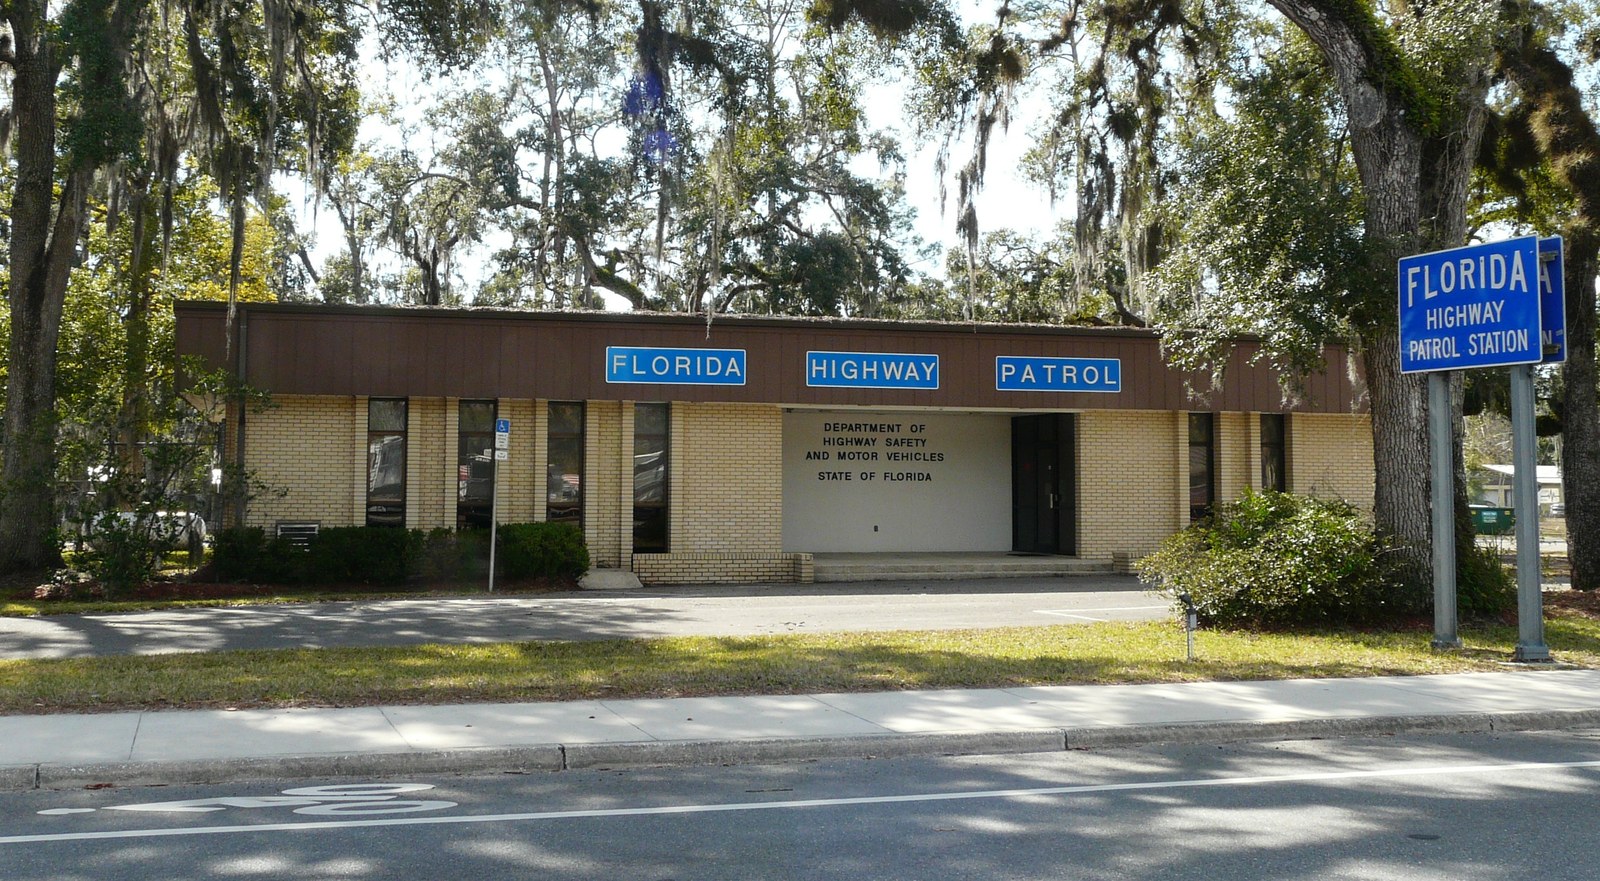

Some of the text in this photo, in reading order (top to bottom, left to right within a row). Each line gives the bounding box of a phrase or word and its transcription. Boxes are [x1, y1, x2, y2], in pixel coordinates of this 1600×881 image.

[1407, 250, 1528, 308] FLORIDA
[1426, 300, 1505, 330] HIGHWAY
[1409, 336, 1461, 361] PATROL
[1468, 328, 1529, 356] STATION
[612, 354, 742, 377] FLORIDA
[811, 358, 936, 380] HIGHWAY
[1001, 363, 1117, 385] PATROL
[823, 422, 926, 434] DEPARTMENT OF
[822, 437, 927, 448] HIGHWAY SAFETY
[805, 451, 945, 462] AND MOTOR VEHICLES
[817, 471, 932, 482] STATE OF FLORIDA
